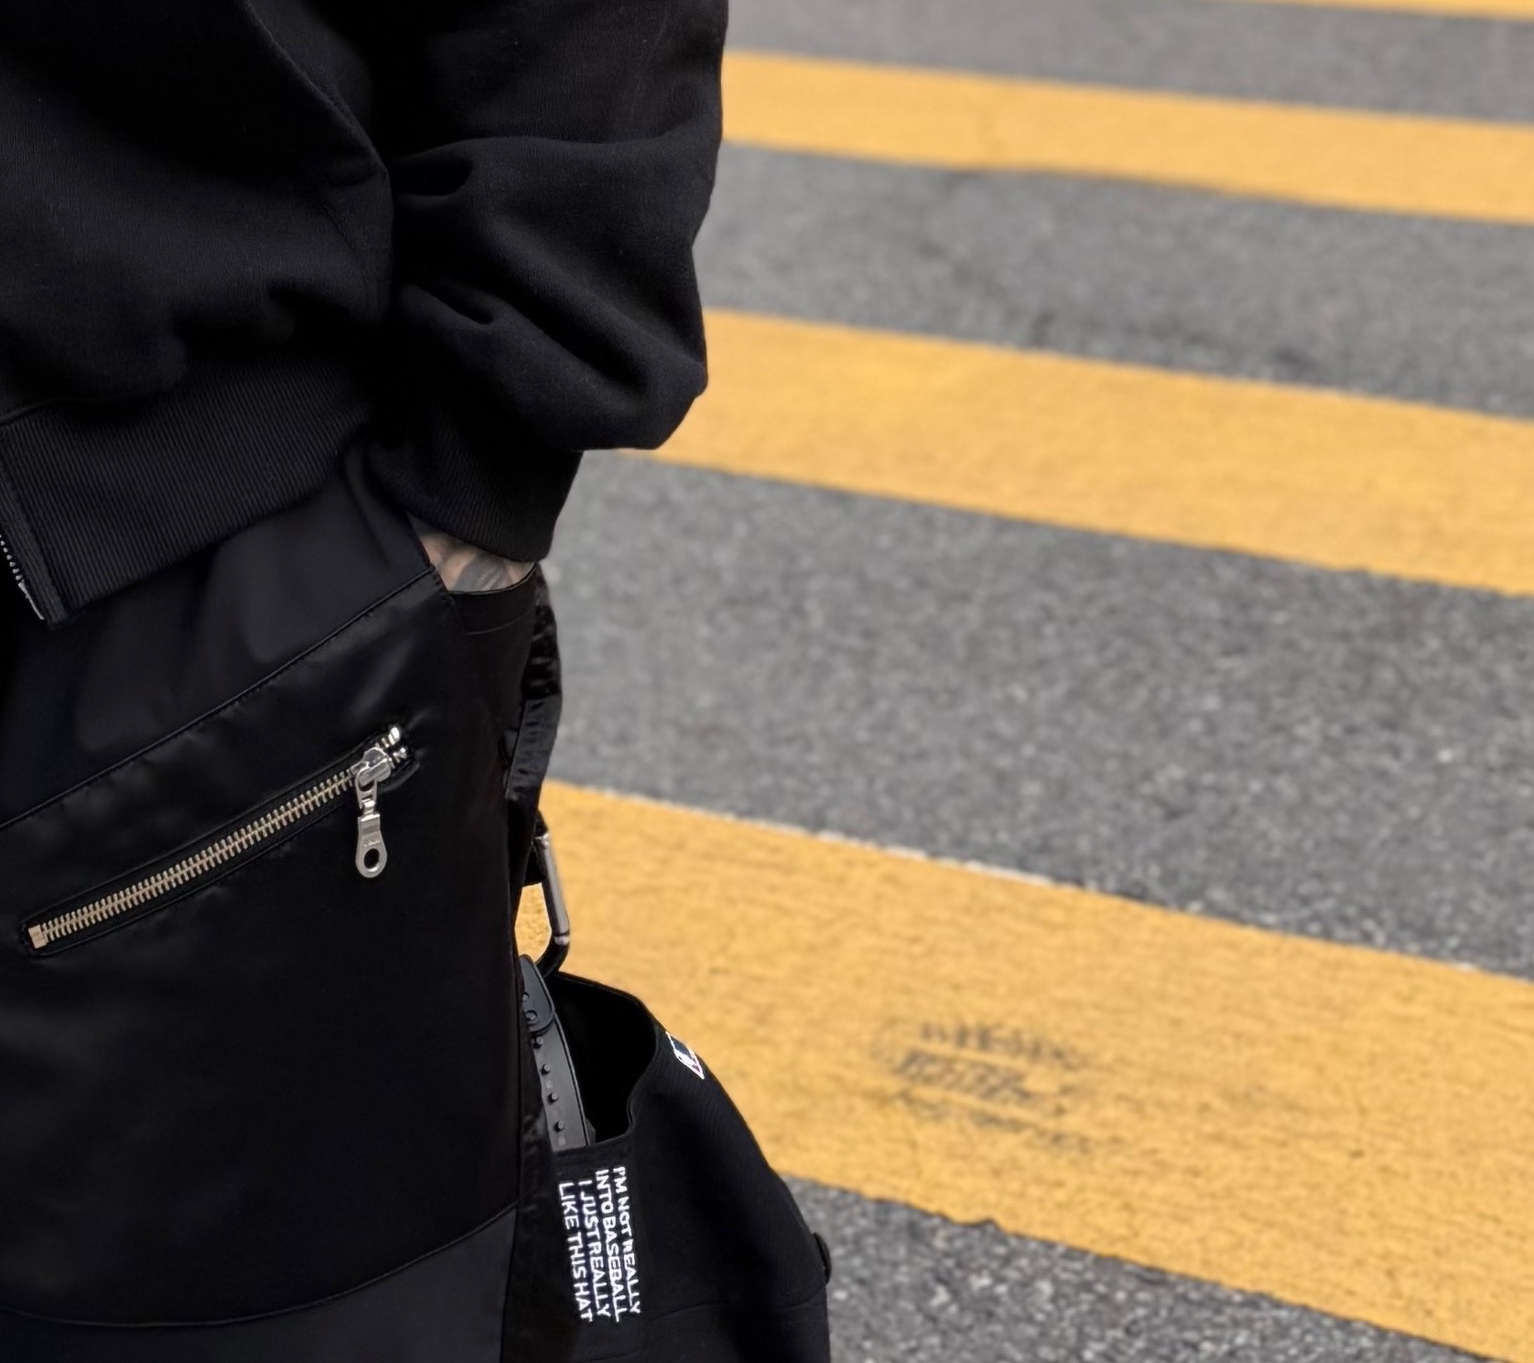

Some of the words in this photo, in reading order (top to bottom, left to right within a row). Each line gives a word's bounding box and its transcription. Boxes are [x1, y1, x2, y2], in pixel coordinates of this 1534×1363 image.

[559, 1182, 579, 1230] LIKE
[580, 1191, 600, 1239] JUST
[596, 1169, 614, 1213] INTO
[618, 1196, 632, 1236] NOT
[567, 1232, 586, 1278] THIS
[589, 1241, 611, 1317] REALLY
[603, 1216, 627, 1322] BASEBALL
[623, 1239, 641, 1314] REALLY
[573, 1282, 593, 1322] HAT
